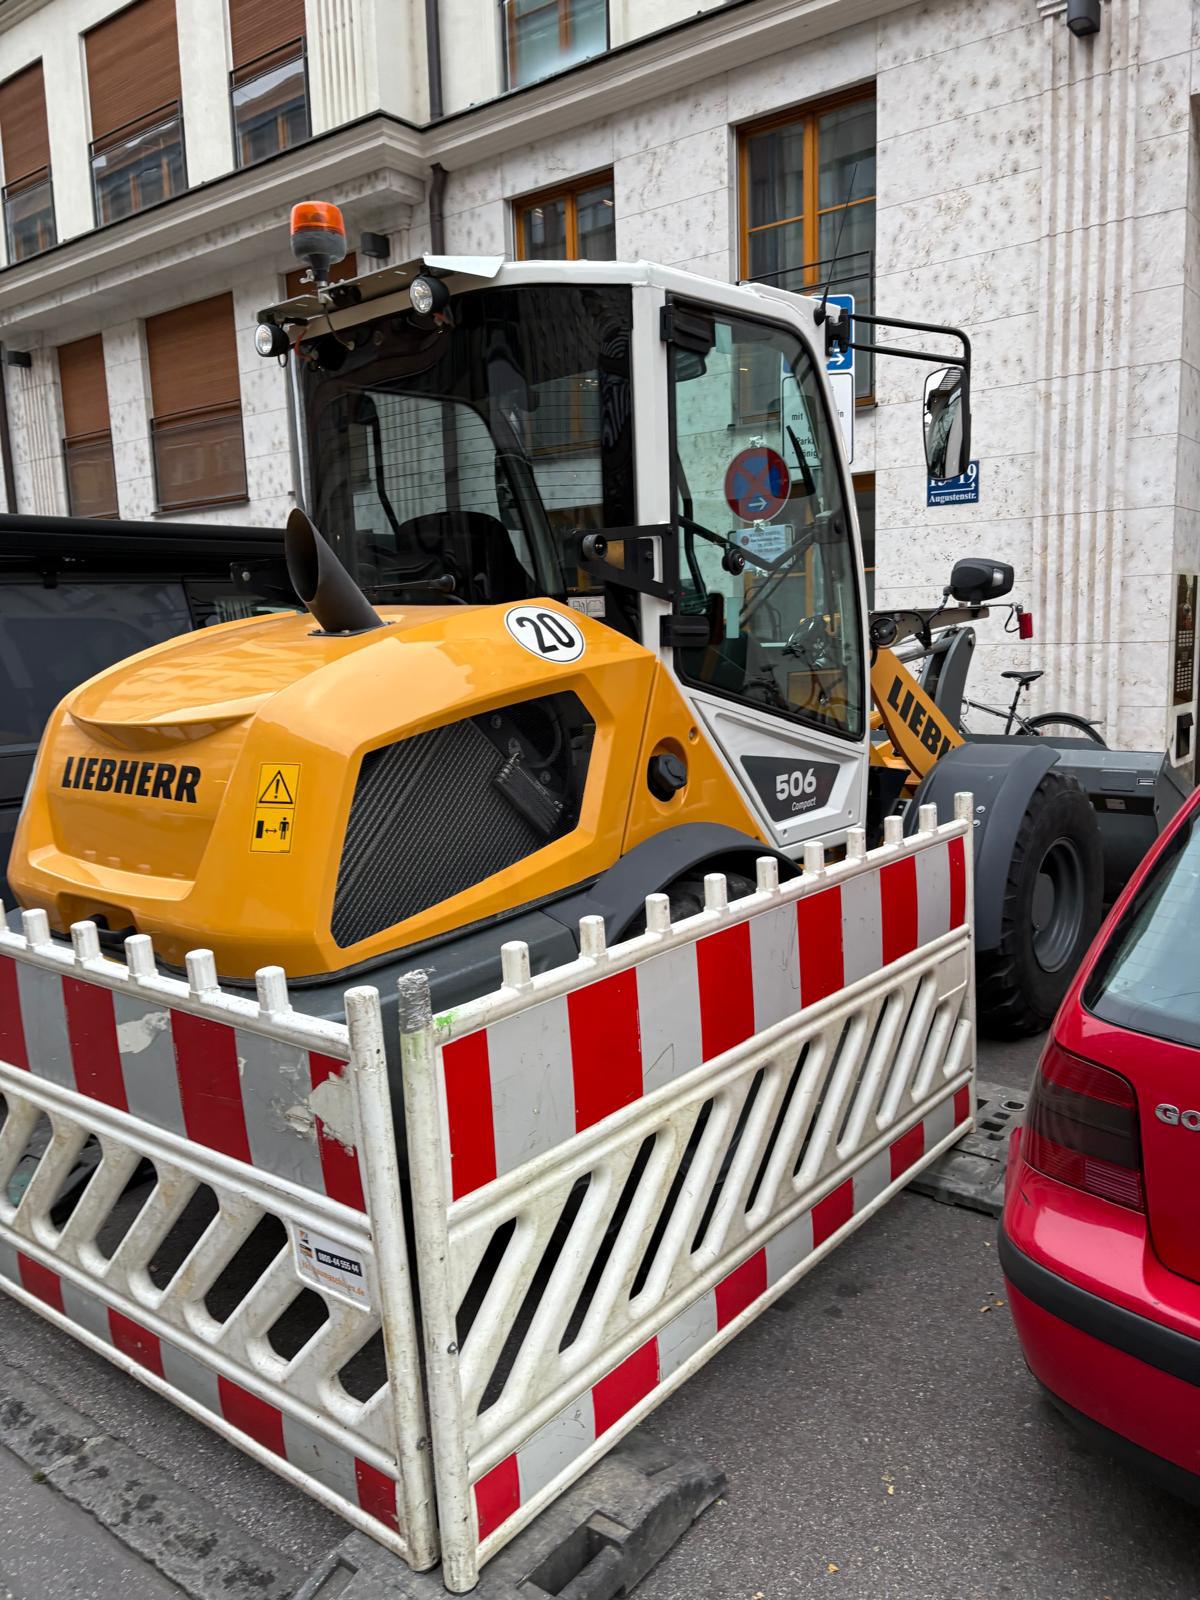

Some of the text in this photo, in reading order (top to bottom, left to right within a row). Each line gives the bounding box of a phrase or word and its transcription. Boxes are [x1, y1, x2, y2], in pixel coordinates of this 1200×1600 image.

[791, 412, 803, 420] mit
[928, 493, 977, 504] Augustenstr.
[515, 612, 576, 654] 20
[61, 756, 201, 803] LIEBHERR
[775, 768, 817, 801] 506
[791, 796, 817, 811] Compact
